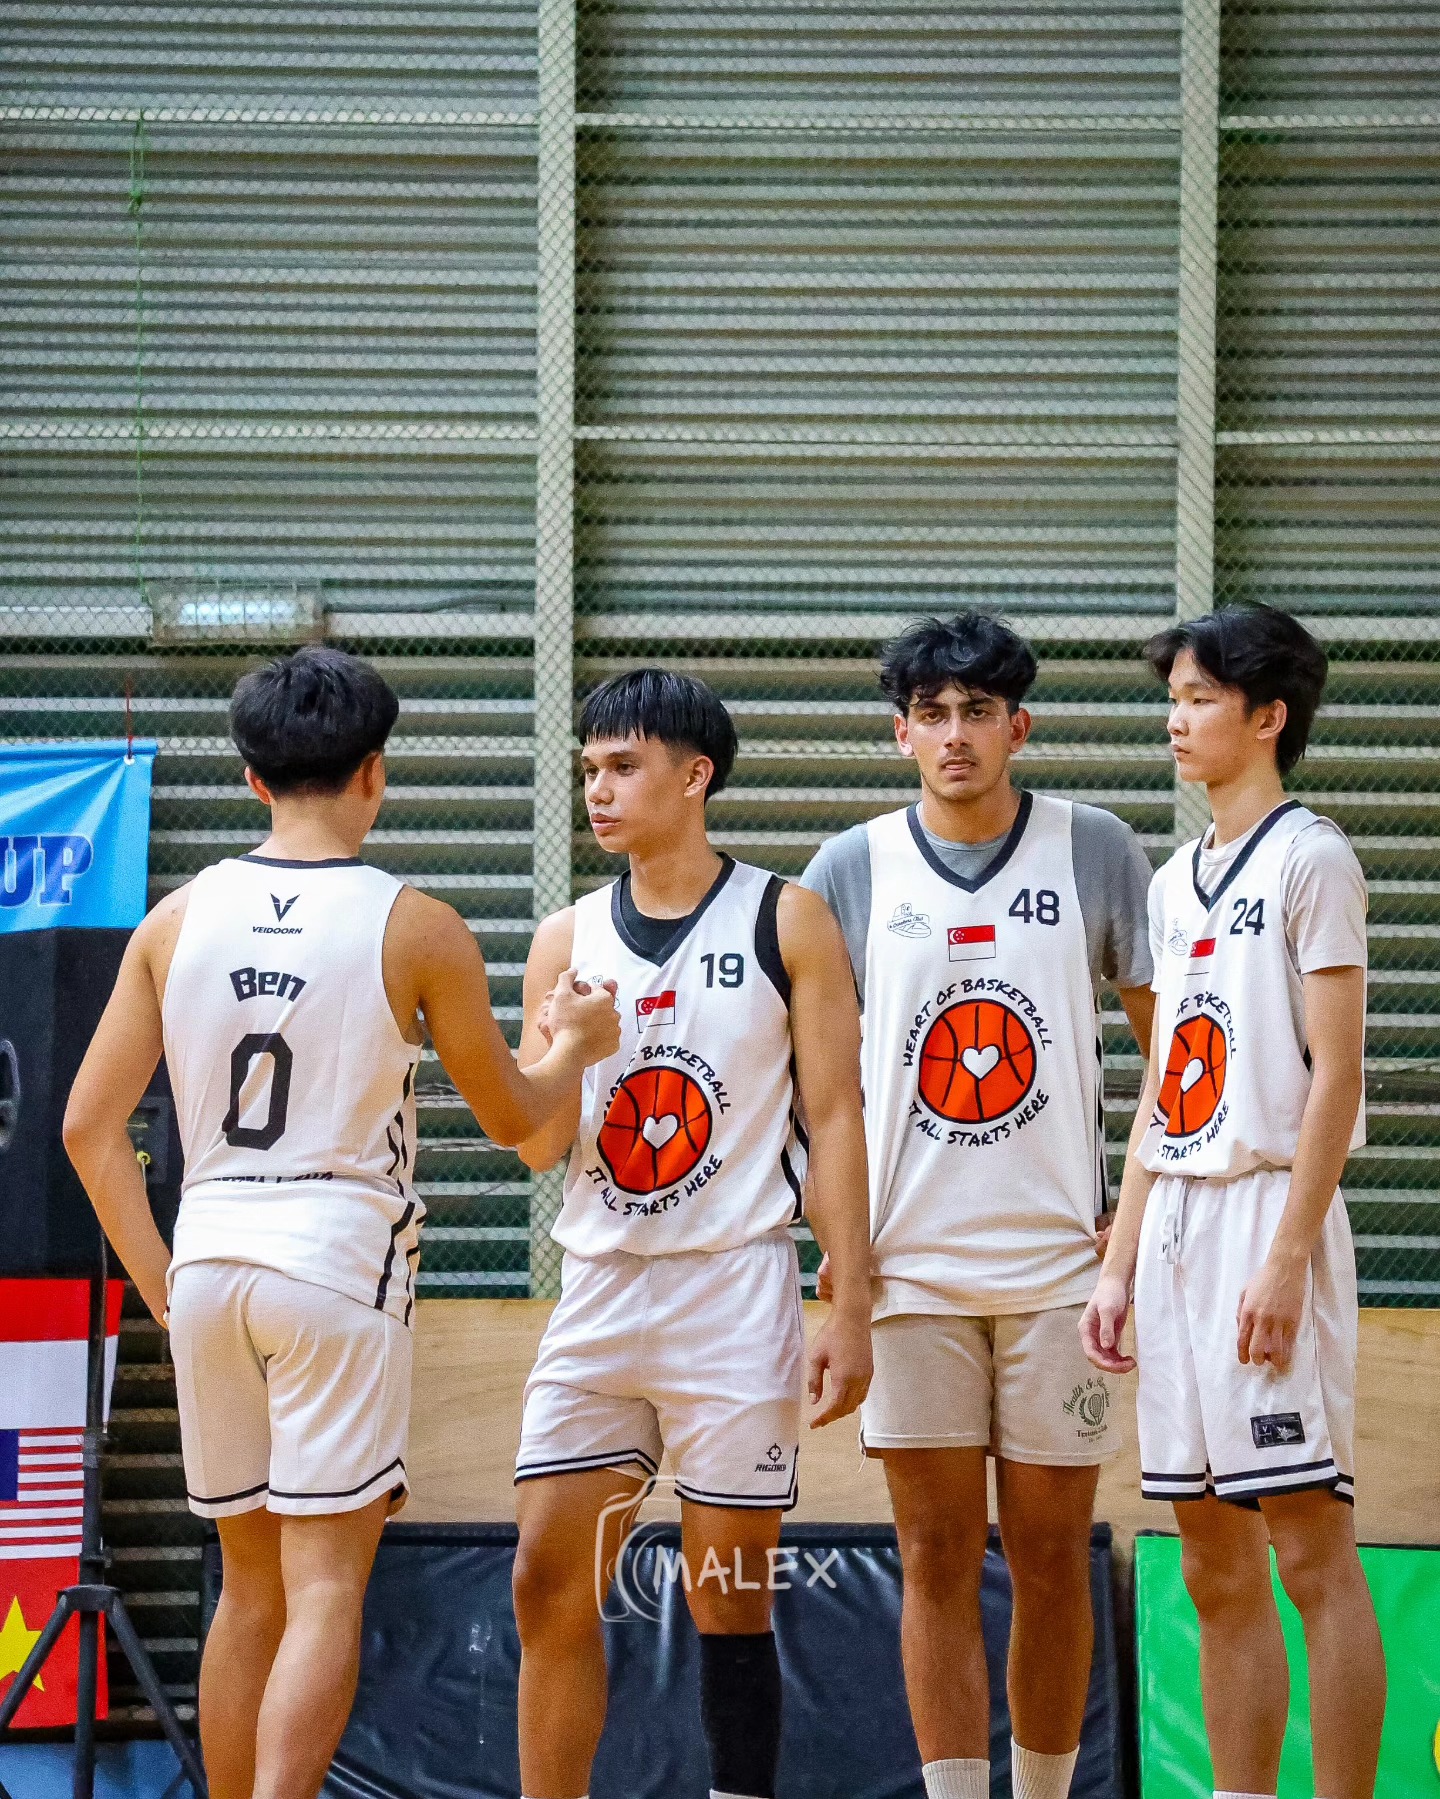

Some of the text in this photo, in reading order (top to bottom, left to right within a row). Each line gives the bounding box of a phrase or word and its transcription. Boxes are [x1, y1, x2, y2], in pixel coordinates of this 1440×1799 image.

[1008, 888, 1060, 926] 48
[1229, 898, 1265, 936] 24
[252, 926, 303, 935] VEIDOORN
[229, 967, 307, 1002] Ben
[700, 952, 744, 989] 19
[904, 978, 1052, 1067] HEART OF BASKETBALL
[222, 1032, 293, 1151] 0
[641, 1044, 731, 1115] BASKETBALL
[916, 1118, 942, 1140] ALL
[947, 1122, 1011, 1147] STARTS
[1014, 1089, 1050, 1129] HERE
[1206, 1101, 1229, 1144] HERE
[585, 1154, 722, 1216] IT ALL STARTS HERE
